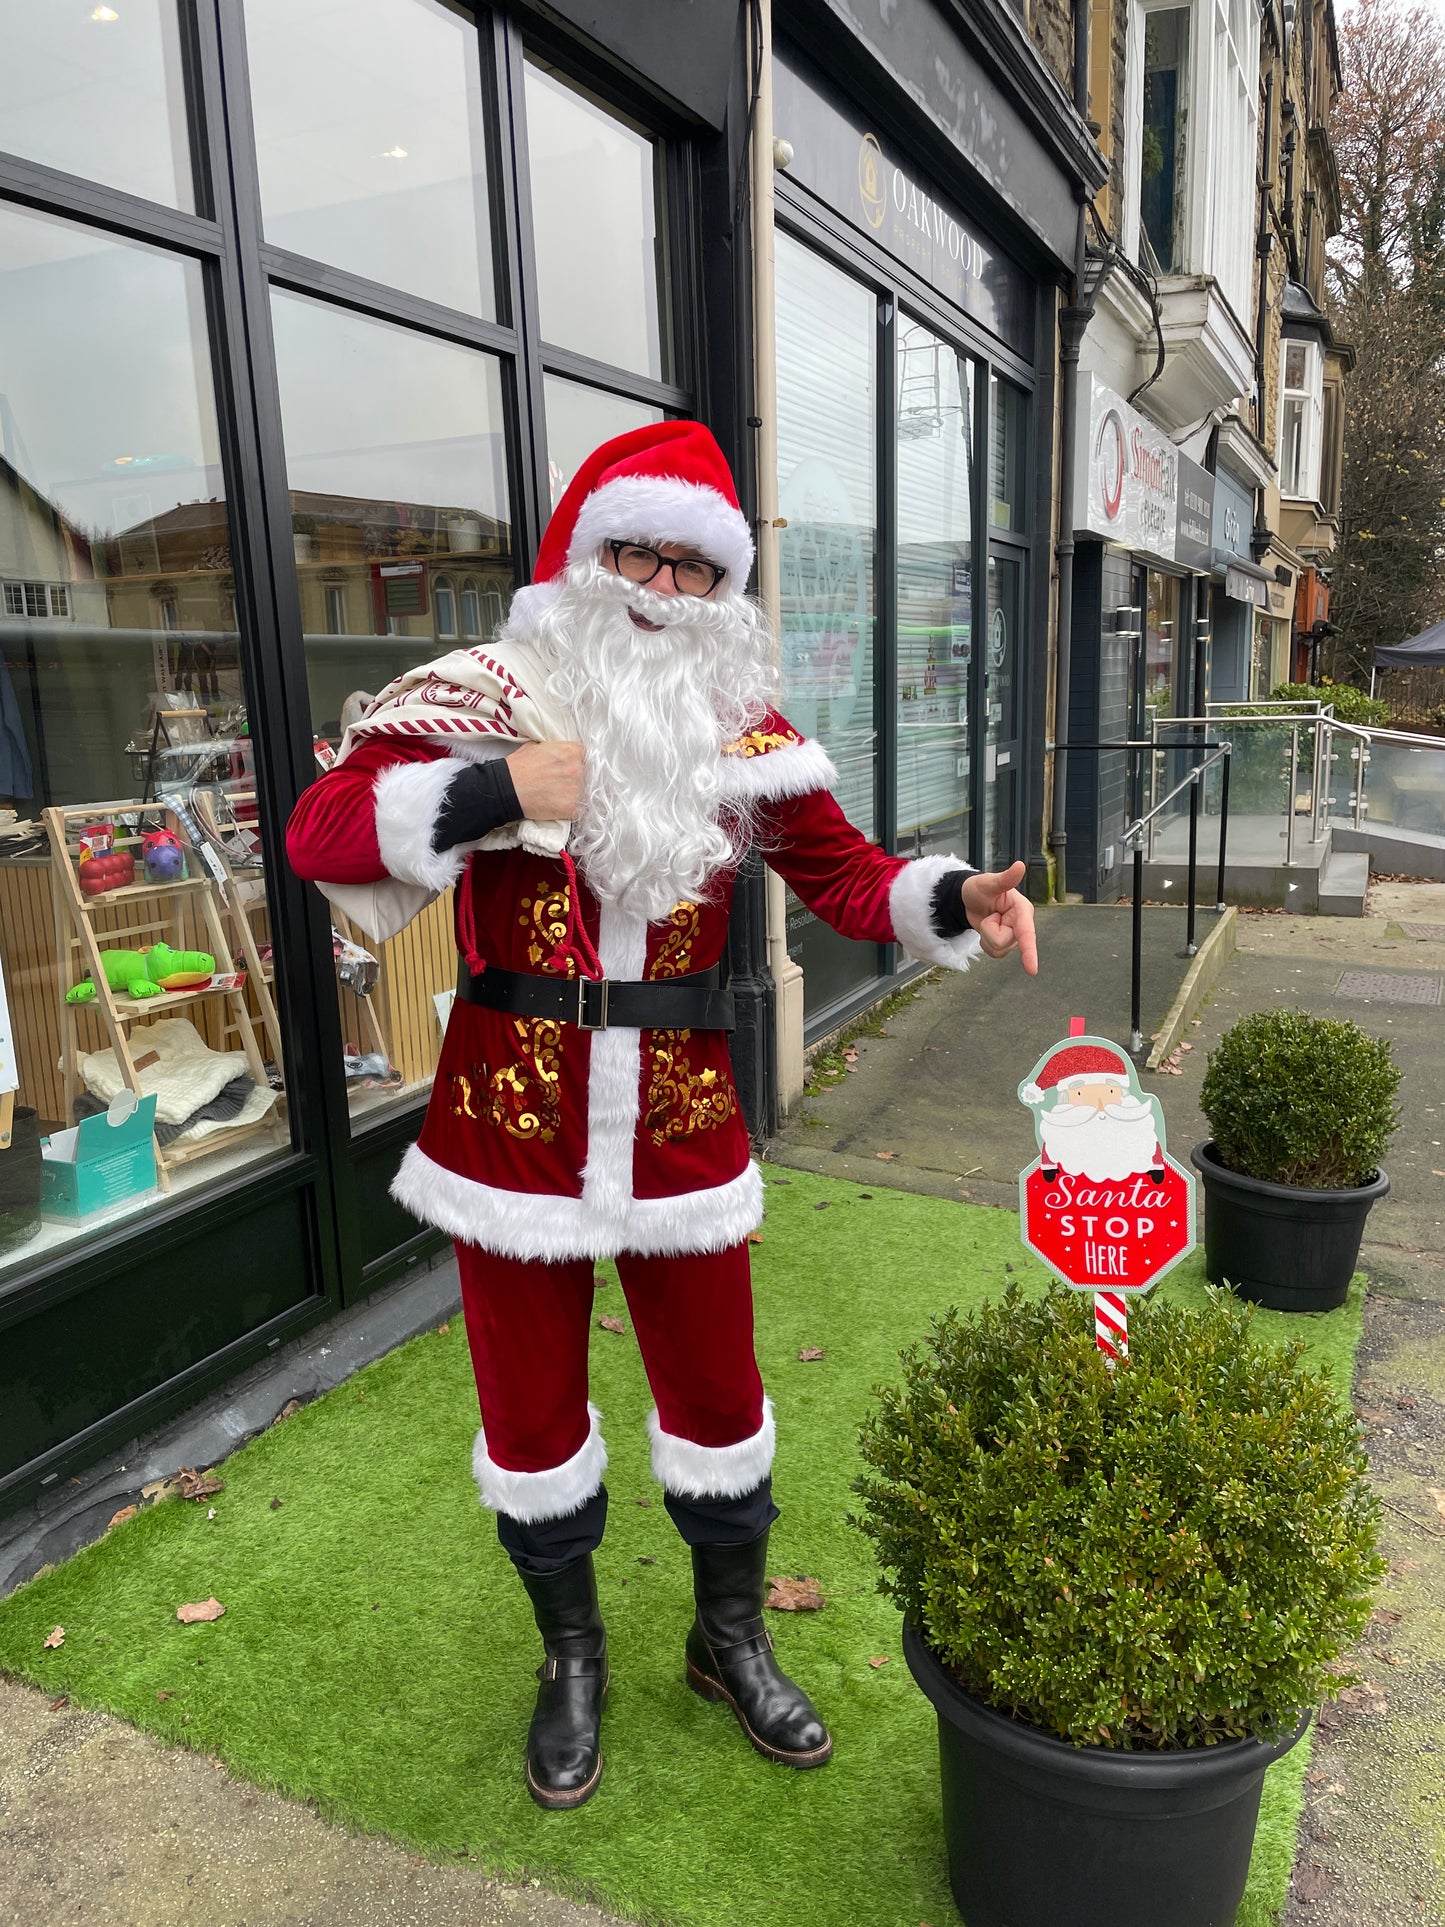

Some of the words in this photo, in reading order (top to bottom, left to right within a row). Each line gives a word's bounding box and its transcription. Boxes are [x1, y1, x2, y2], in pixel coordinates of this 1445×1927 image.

[893, 168, 983, 280] OAKWOOD
[1044, 1174, 1173, 1210] Santa
[1060, 1215, 1155, 1239] STOP
[1085, 1240, 1129, 1277] HERE
